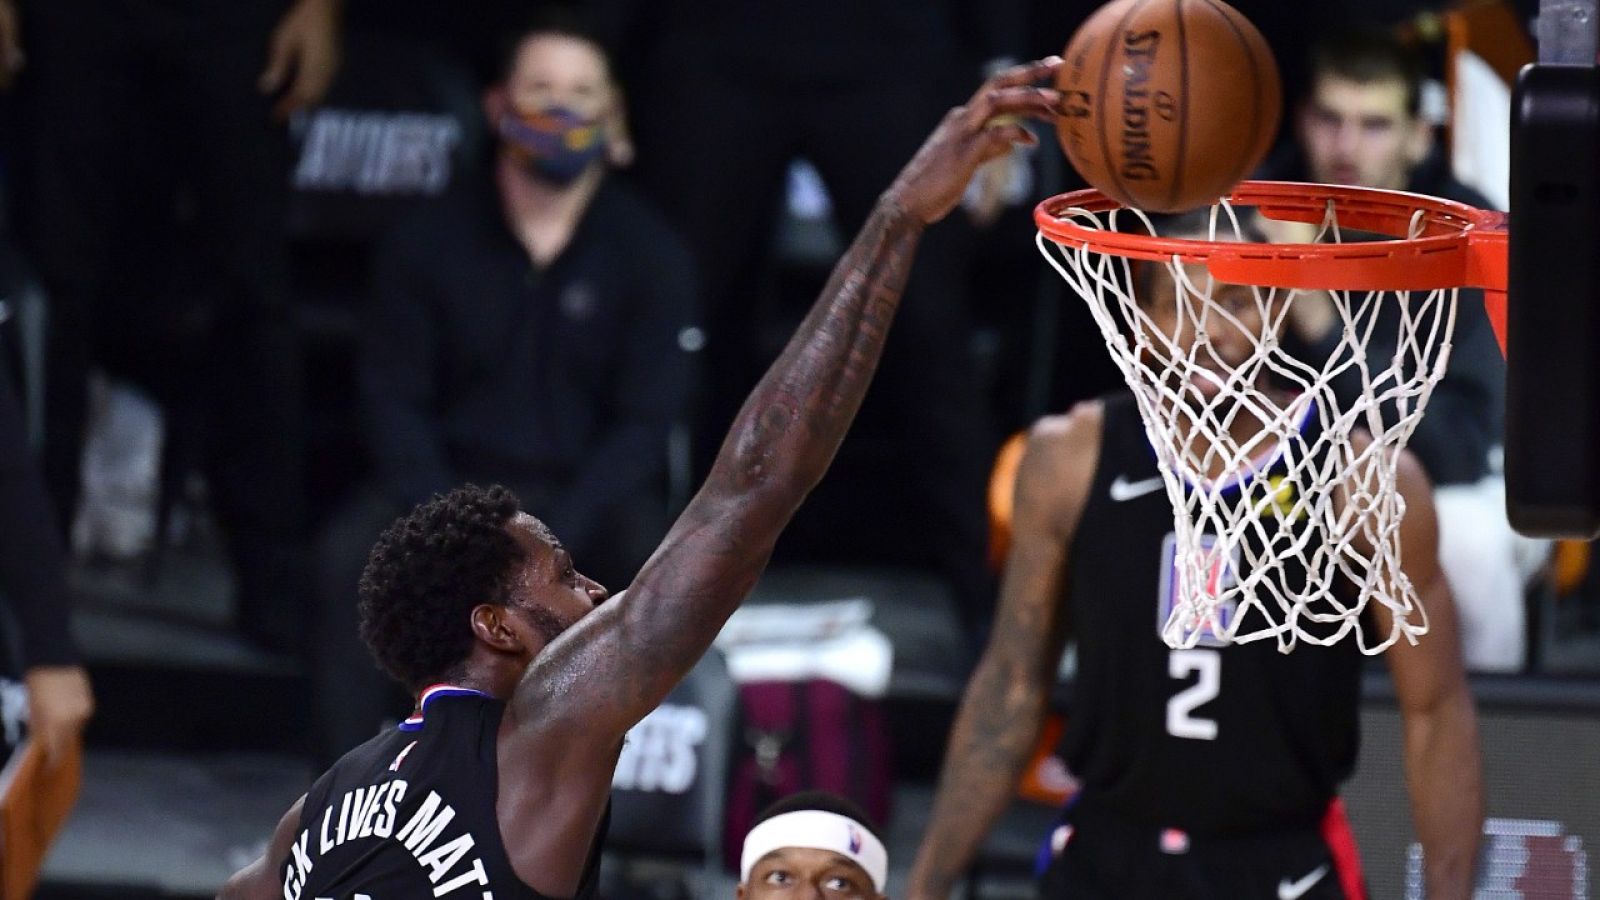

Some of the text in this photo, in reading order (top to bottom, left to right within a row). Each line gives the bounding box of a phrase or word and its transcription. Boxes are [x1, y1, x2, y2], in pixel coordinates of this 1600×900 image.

[1121, 29, 1160, 181] SPALDING
[1166, 650, 1222, 740] 2
[320, 779, 408, 856] LIVES
[395, 790, 493, 900] MAT
